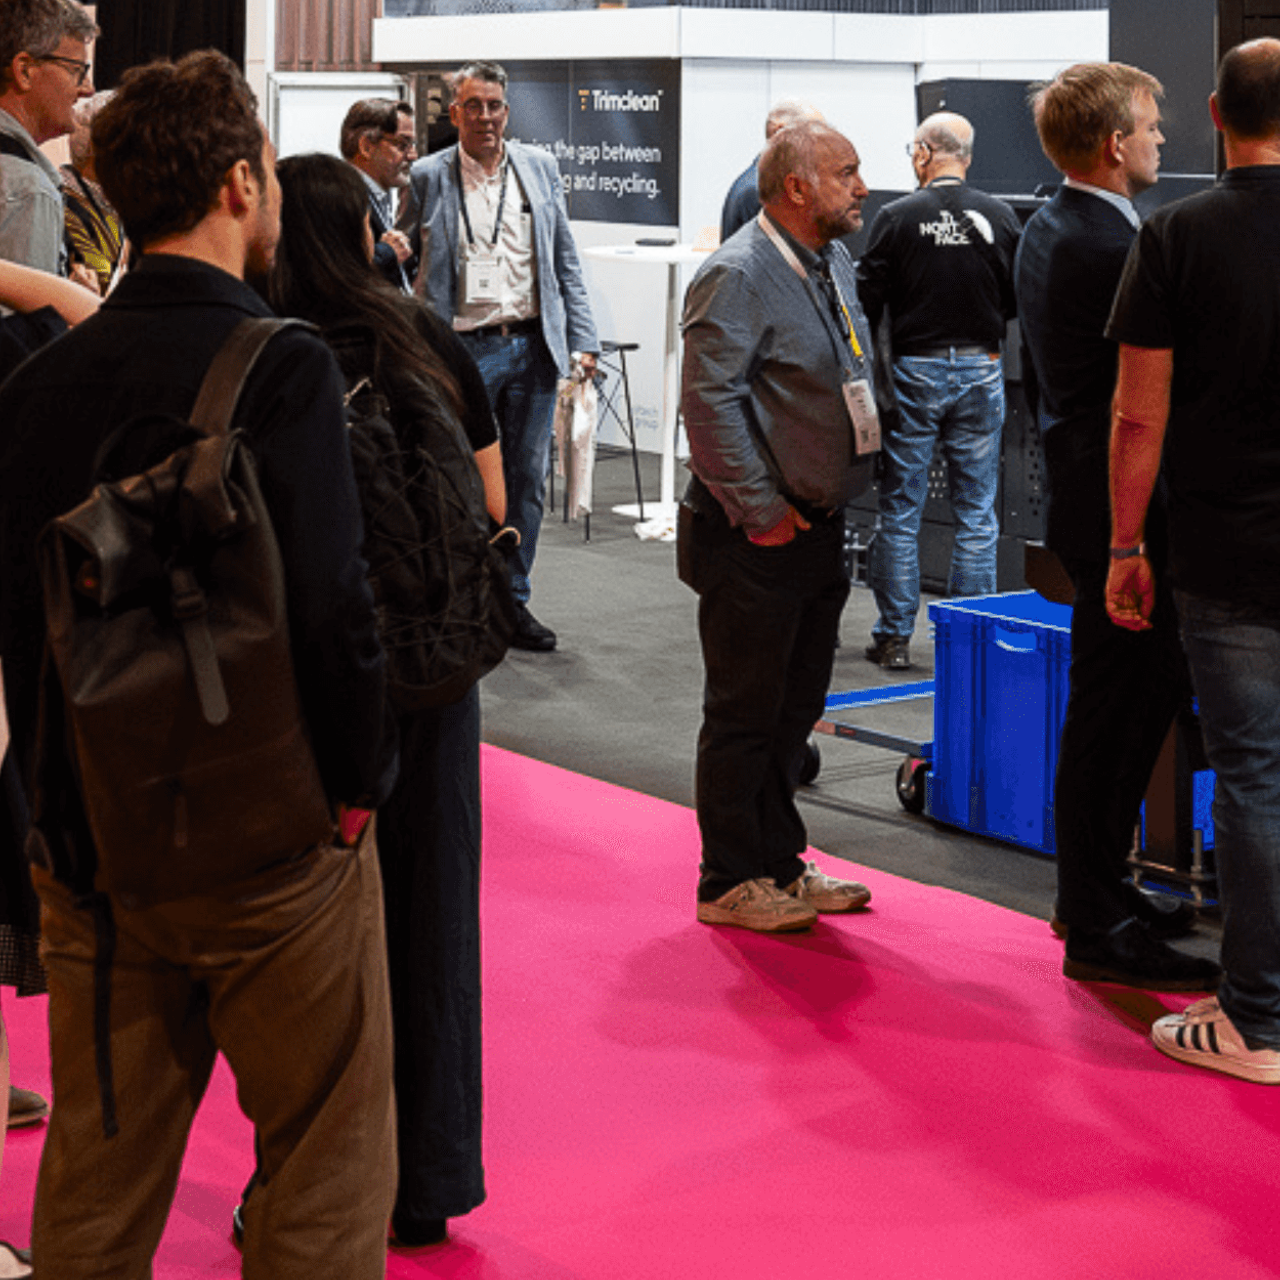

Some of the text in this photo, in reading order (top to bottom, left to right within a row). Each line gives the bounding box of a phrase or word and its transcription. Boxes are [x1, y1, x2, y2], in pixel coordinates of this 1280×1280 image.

[577, 144, 600, 166] gap
[601, 141, 662, 163] between
[573, 171, 598, 192] and
[598, 172, 661, 200] recycling.
